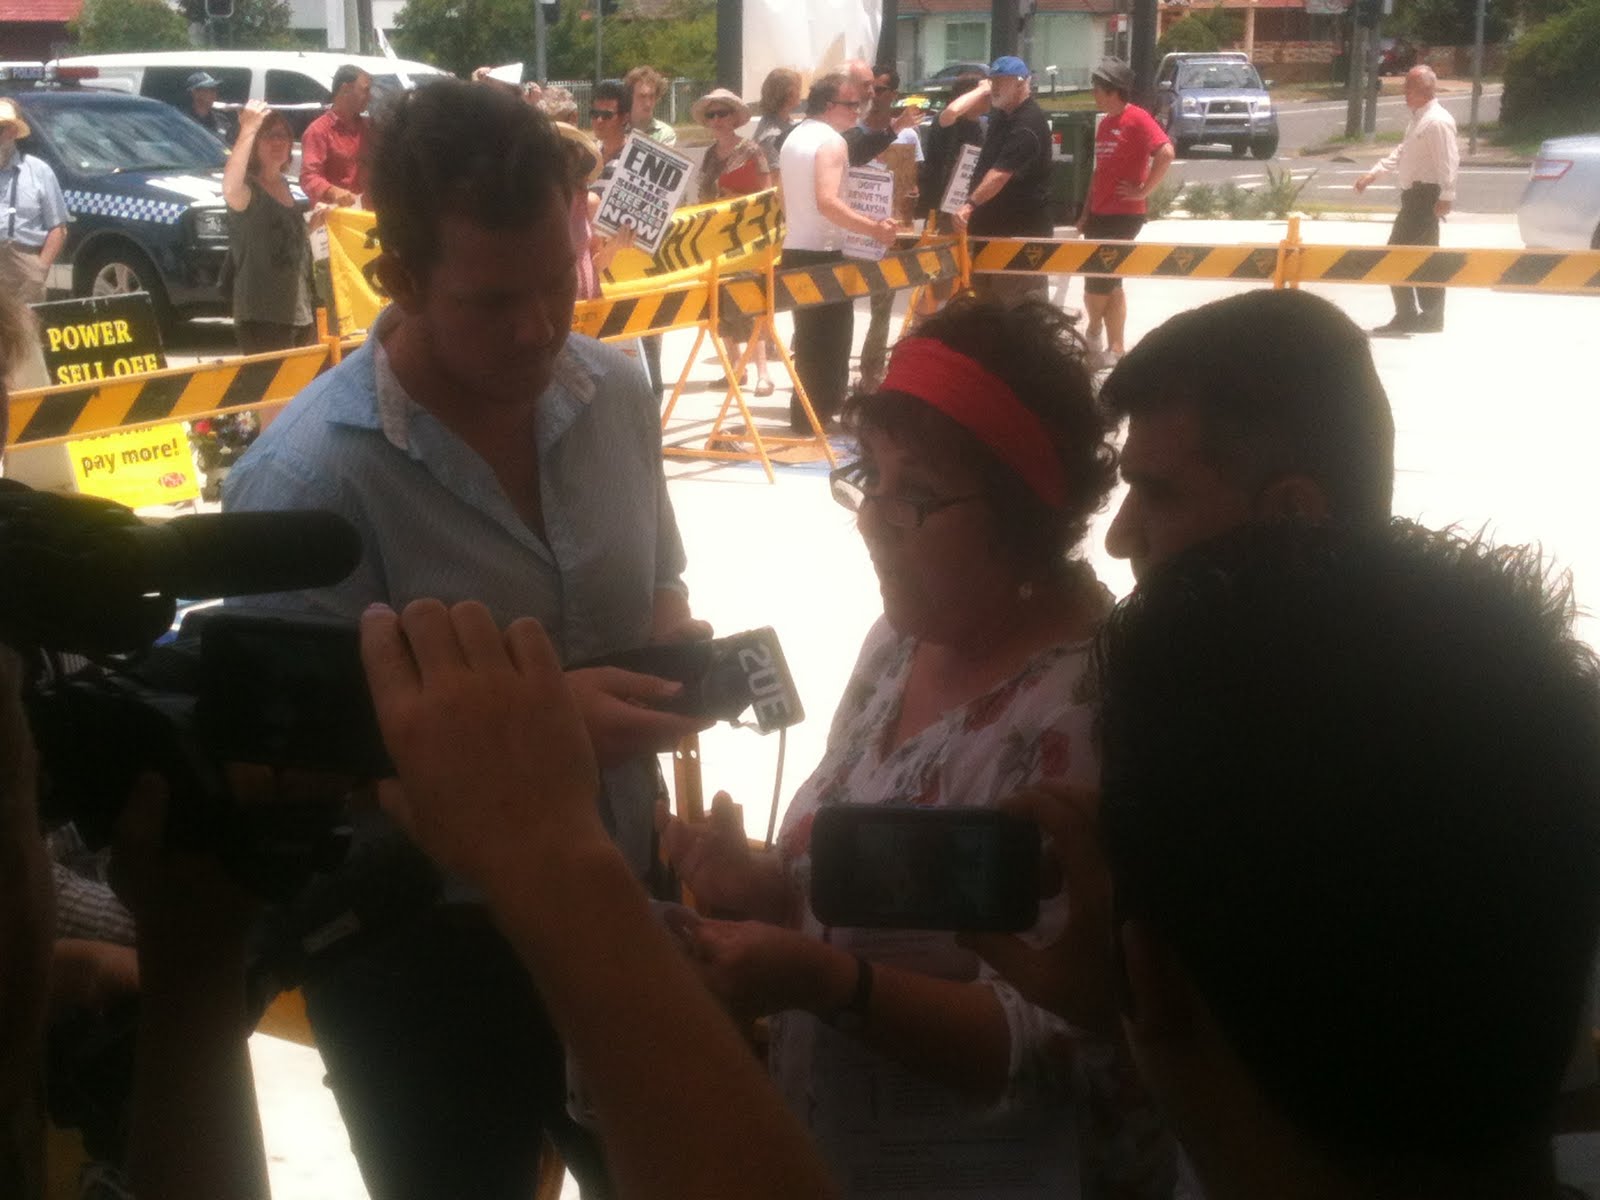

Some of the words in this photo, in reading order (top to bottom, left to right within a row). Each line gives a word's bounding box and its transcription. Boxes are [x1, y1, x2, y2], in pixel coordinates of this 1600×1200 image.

[624, 144, 683, 192] END
[626, 170, 668, 198] THE
[610, 184, 642, 209] FREE
[850, 201, 887, 215] MALAYSIA
[601, 204, 660, 241] NOW
[46, 320, 133, 352] POWER
[57, 360, 108, 385] SELL
[81, 451, 116, 477] pay
[121, 437, 180, 464] more!
[738, 643, 791, 724] 2UE
